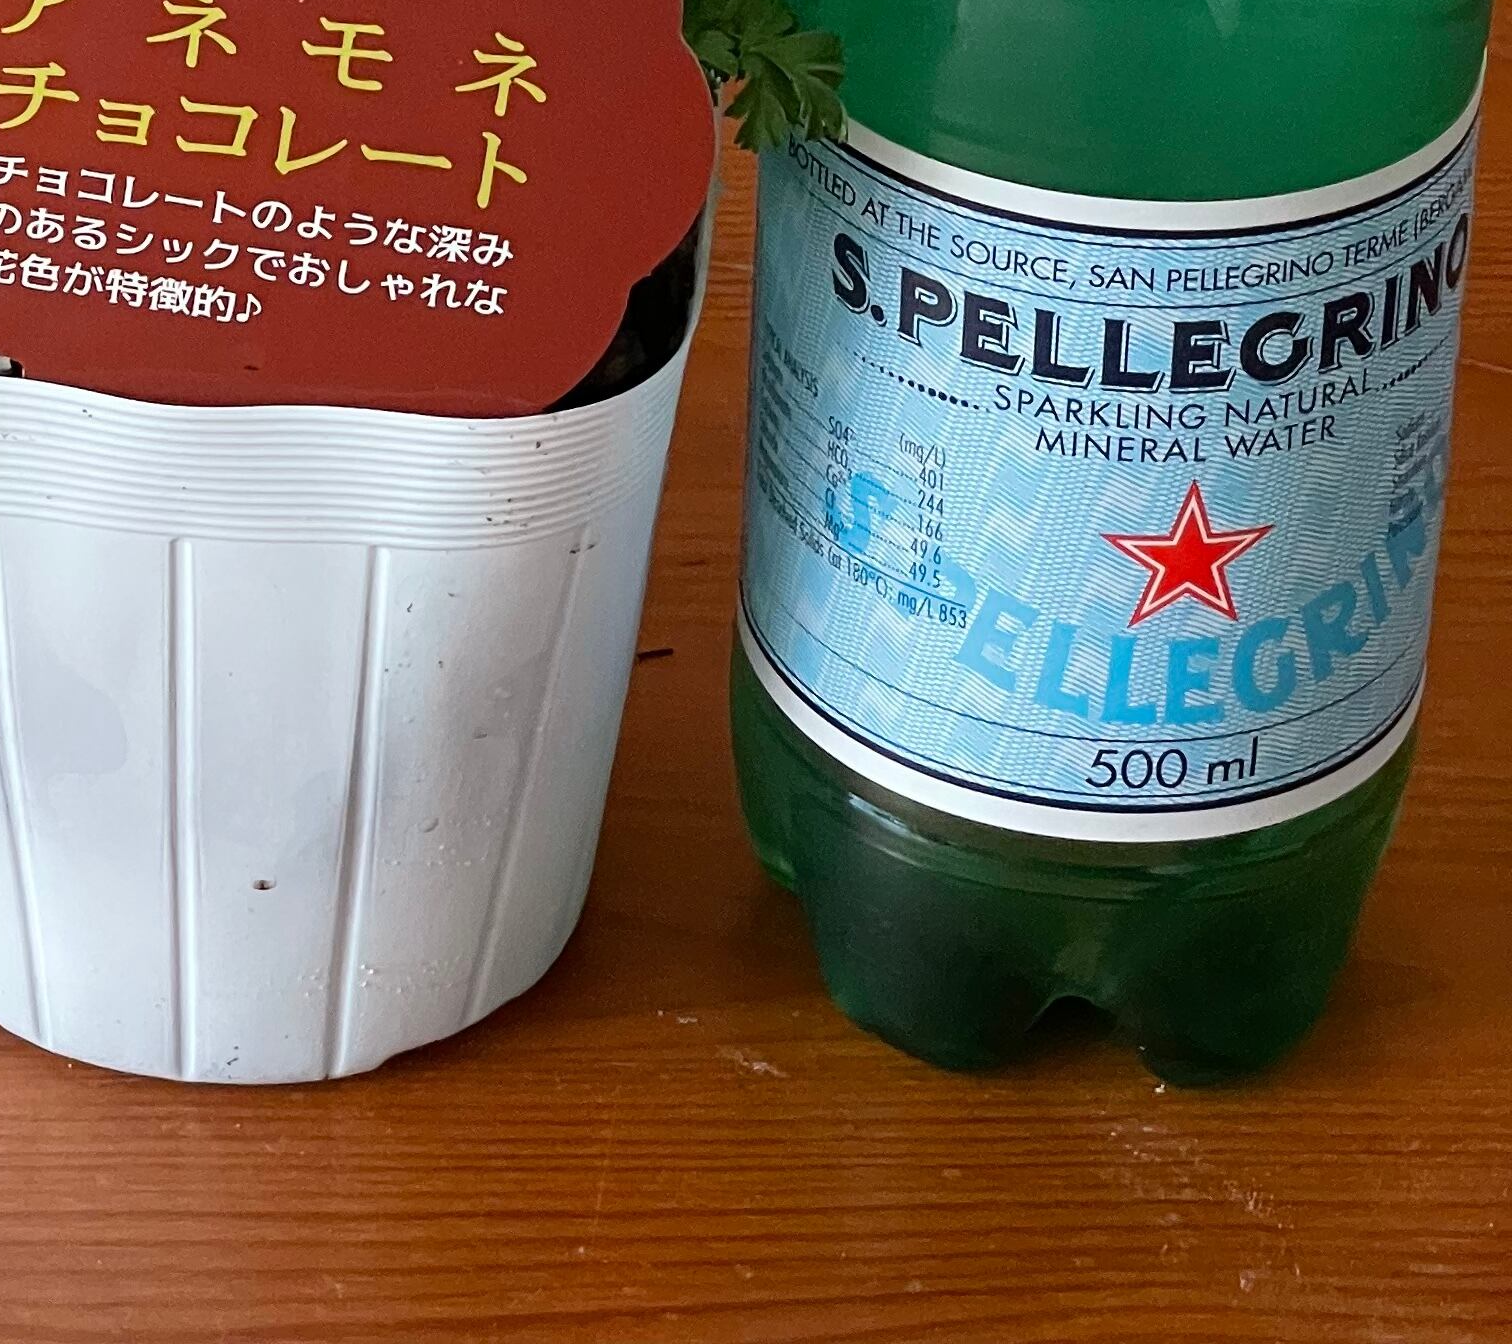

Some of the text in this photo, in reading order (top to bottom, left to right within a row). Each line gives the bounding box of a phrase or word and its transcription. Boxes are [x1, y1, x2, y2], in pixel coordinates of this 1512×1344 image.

[788, 132, 856, 207] BOTTLED
[860, 196, 891, 227] AT
[896, 211, 941, 251] THE
[949, 234, 1077, 290] SOURCE,
[1088, 263, 1155, 293] SAN
[1166, 250, 1335, 293] PELLEGRINO
[1343, 222, 1409, 268] TERME
[830, 213, 1469, 394] S.PELLEGRINO
[992, 384, 1207, 431] SPARKLING
[1224, 368, 1381, 427] NATURAL
[1034, 414, 1337, 464] MINERAL WATER
[918, 465, 944, 491] 401
[917, 488, 944, 518] 244
[917, 513, 944, 542] 166
[909, 562, 942, 589] 49.5
[897, 590, 933, 619] mg/L
[938, 603, 967, 629] 853
[1084, 735, 1260, 791] 500 ml
